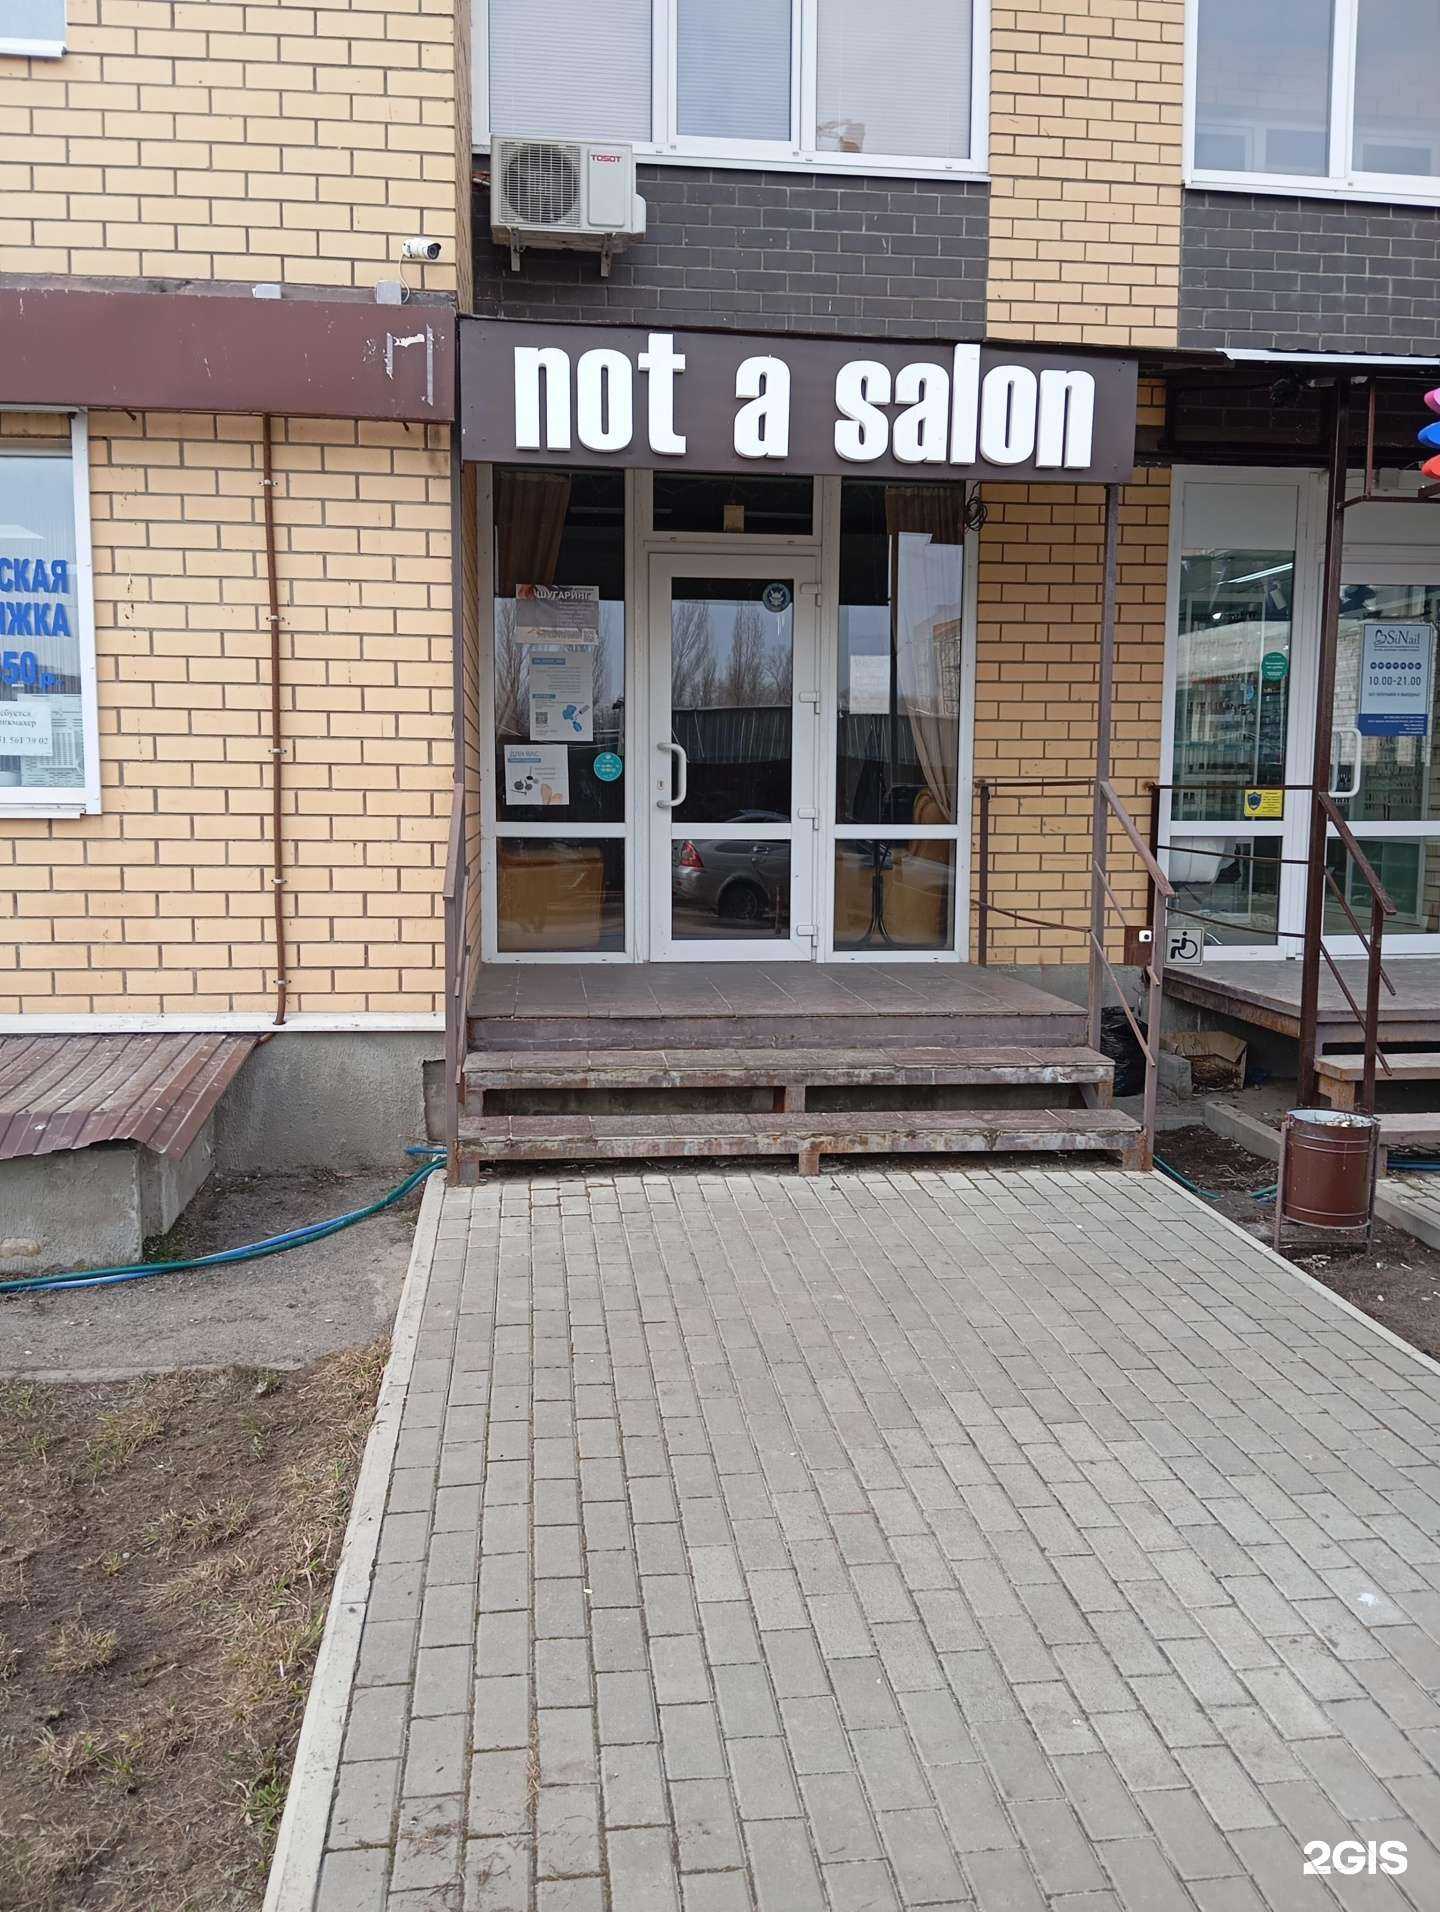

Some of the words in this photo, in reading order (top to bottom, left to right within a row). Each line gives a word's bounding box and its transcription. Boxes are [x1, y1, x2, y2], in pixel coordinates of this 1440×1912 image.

[590, 154, 622, 163] TOSOT
[514, 333, 687, 455] not
[734, 355, 792, 460] a
[833, 343, 1096, 469] salon
[0, 558, 70, 593] СКАЯ
[536, 590, 591, 600] ШУГАРИНГ
[1369, 676, 1421, 686] 10.00-21.00
